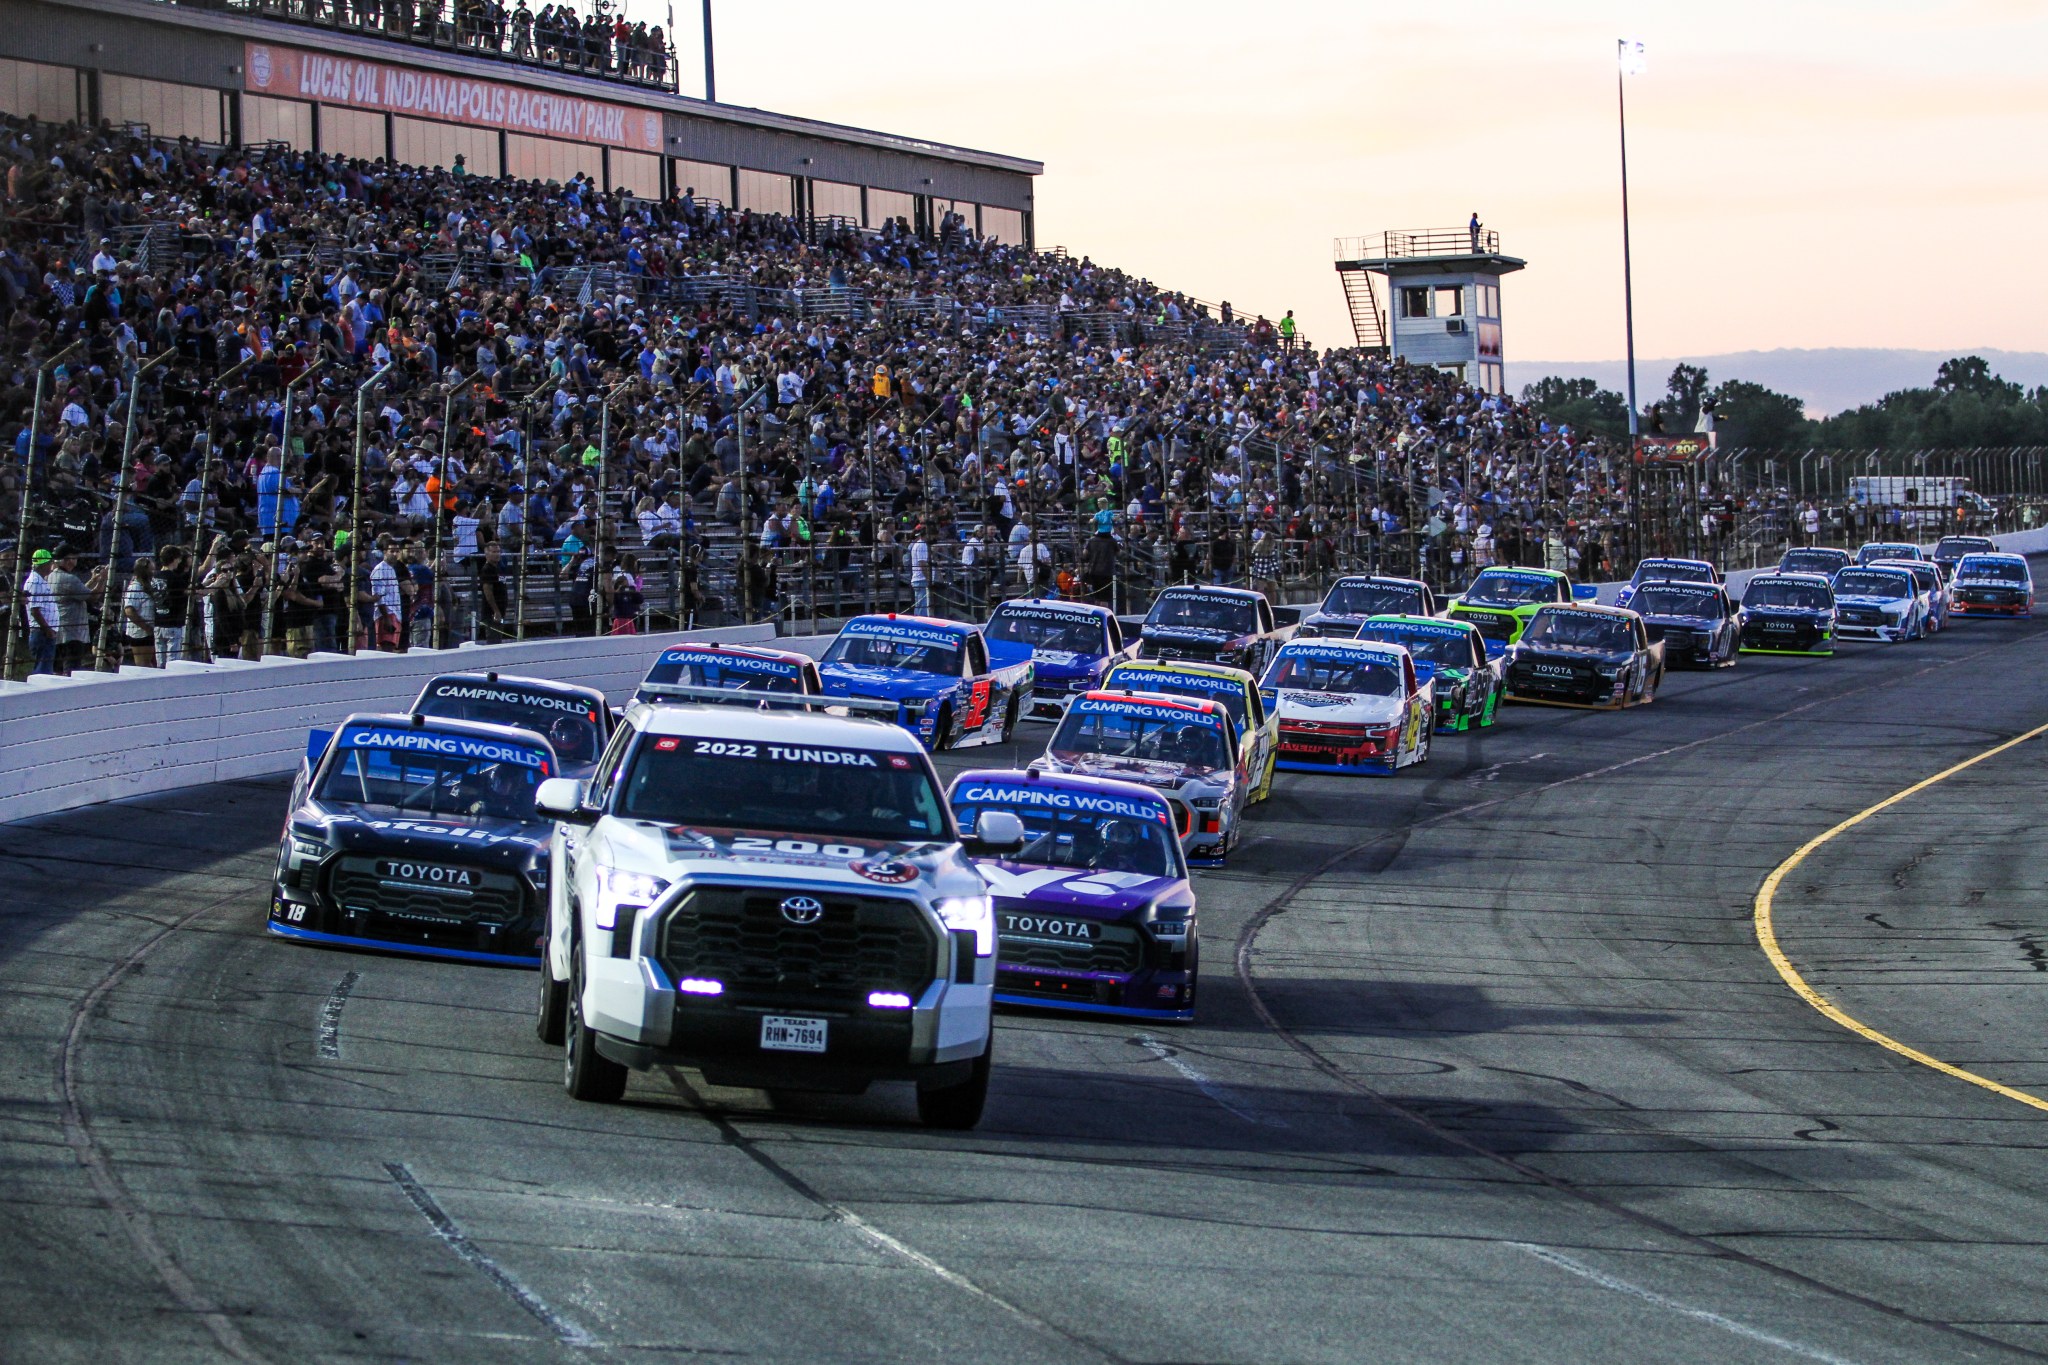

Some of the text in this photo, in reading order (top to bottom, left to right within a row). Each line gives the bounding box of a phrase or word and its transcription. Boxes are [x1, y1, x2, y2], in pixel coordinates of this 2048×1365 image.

[301, 55, 352, 100] LUCAS
[355, 64, 378, 104] OIL
[384, 70, 506, 122] INDIANAPOLIS
[508, 91, 586, 135] RACEWAY
[586, 102, 625, 142] PARK
[1520, 574, 1550, 583] WORLD
[1340, 582, 1416, 594] CAMPING WORLD
[1682, 588, 1714, 597] WORLD
[1164, 592, 1248, 607] CAMPING WORLD
[1002, 609, 1096, 624] CAMPING WORLD
[1468, 613, 1498, 621] TOYOTA
[1543, 608, 1628, 622] CAMPING WORLD
[850, 623, 955, 642] CAMPING WORLD
[1368, 622, 1462, 637] CAMPING WORLD
[668, 652, 790, 674] CAMPING WORLD
[1286, 647, 1392, 664] CAMPING WORLD
[1535, 664, 1572, 675] TOYOTA
[1118, 672, 1237, 692] CAMPING WORLD
[437, 686, 589, 715] CAMPING WORLD
[964, 680, 990, 729] 52
[1080, 701, 1214, 725] CAMPING WORLD
[353, 732, 542, 767] CAMPING WORLD
[694, 741, 878, 767] 2022 TUNDRA
[966, 788, 1156, 820] CAMPING WORLD
[731, 837, 865, 858] 200
[387, 862, 470, 885] TOYOTA
[864, 872, 907, 882] TOOLS
[288, 904, 306, 921] 18
[384, 911, 462, 925] TUNDRA
[1006, 916, 1090, 938] TOYOTA
